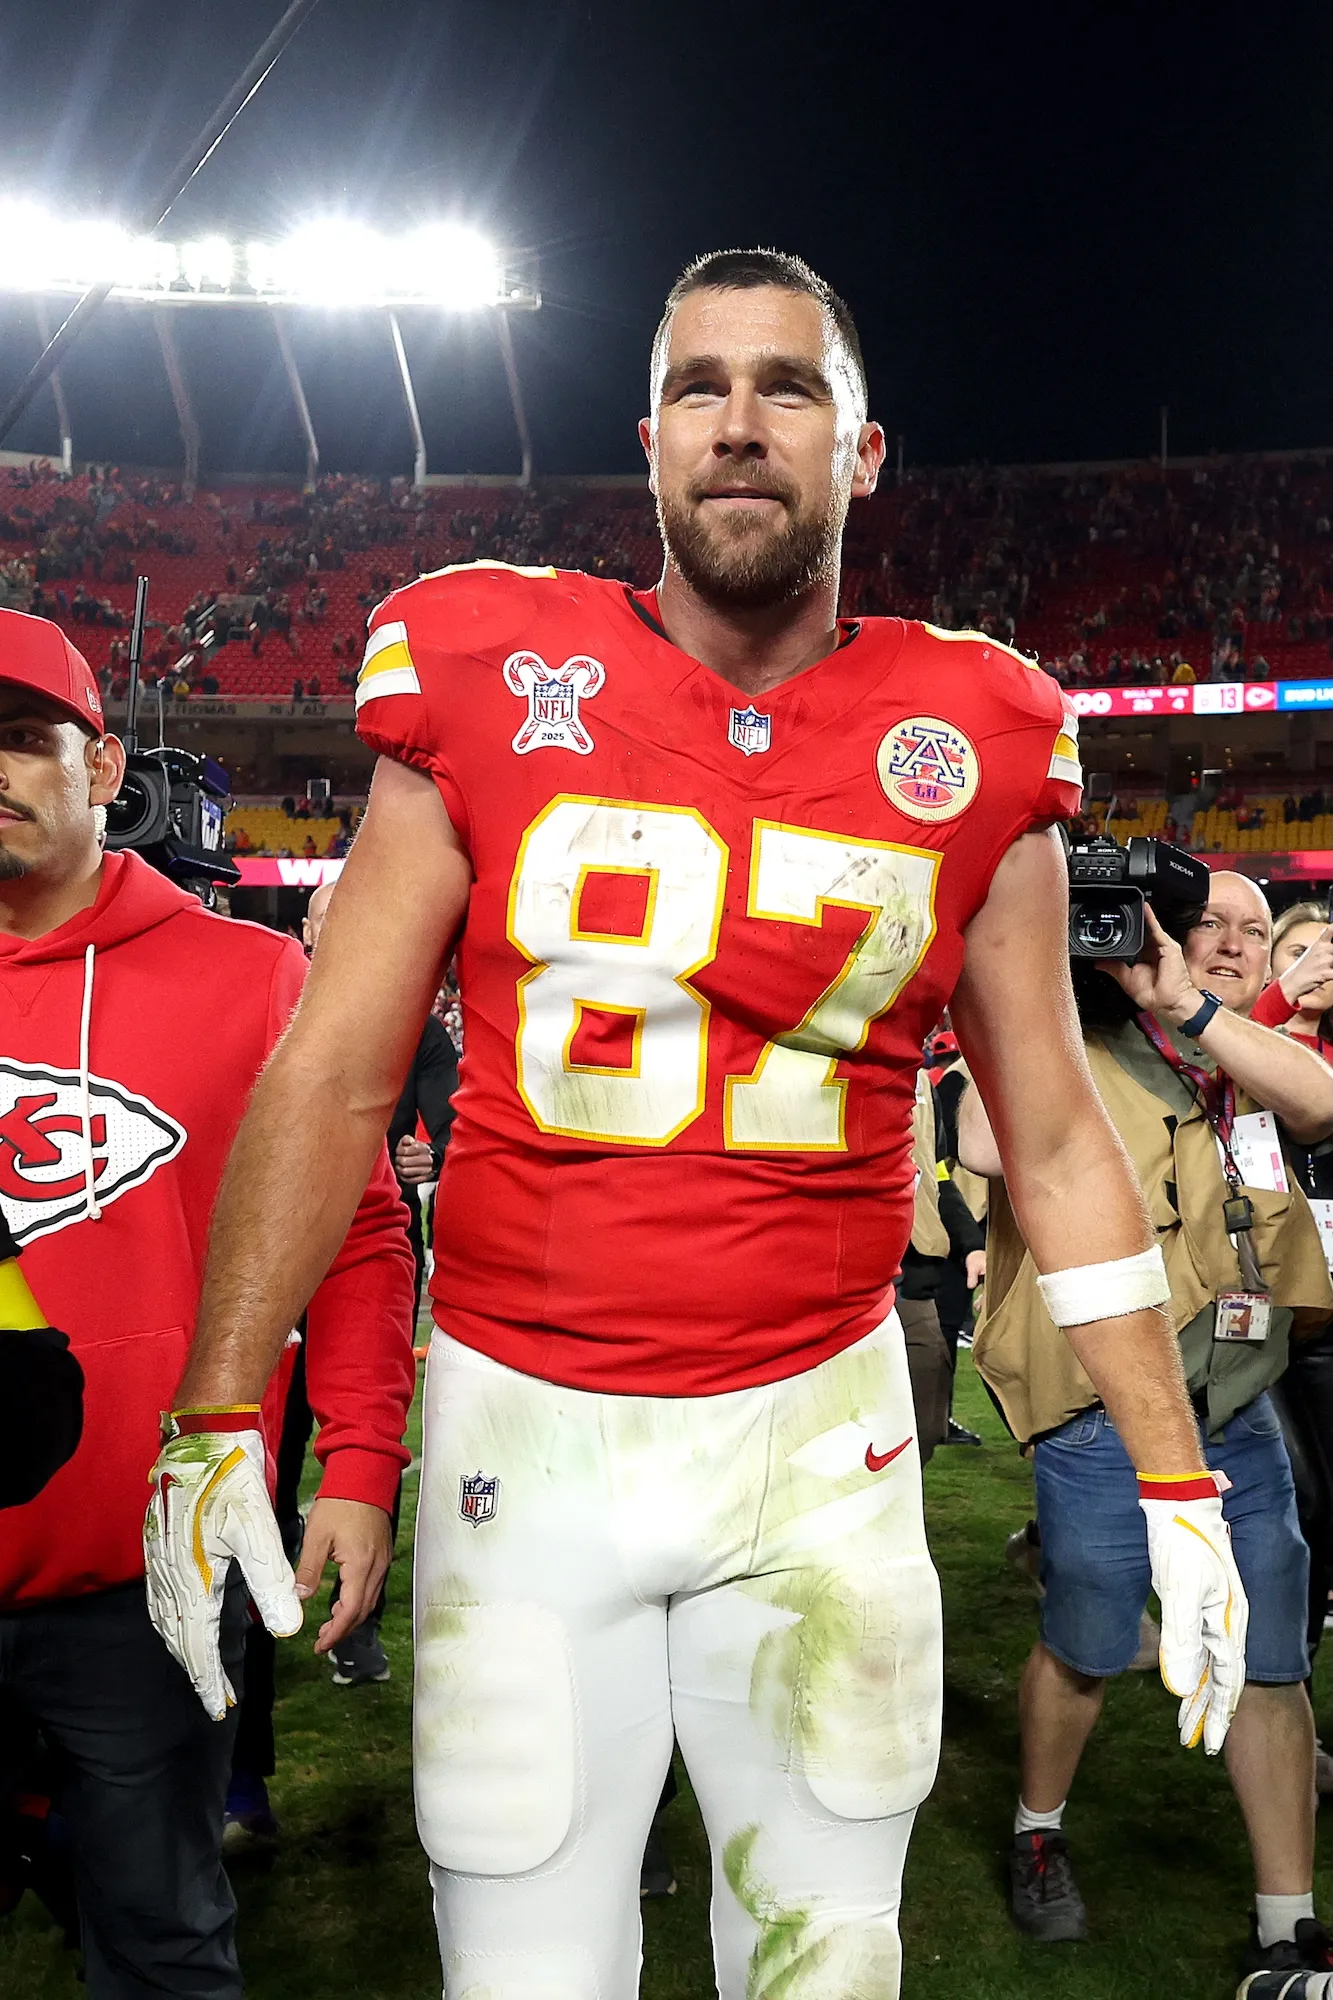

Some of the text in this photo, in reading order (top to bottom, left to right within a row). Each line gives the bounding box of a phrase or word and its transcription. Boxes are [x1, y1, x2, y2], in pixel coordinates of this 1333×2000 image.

[1220, 687, 1237, 709] 13
[537, 699, 570, 721] NFL
[541, 732, 565, 741] 2025
[737, 726, 763, 746] NFL
[505, 792, 945, 1152] 87
[464, 1495, 490, 1517] NFL
